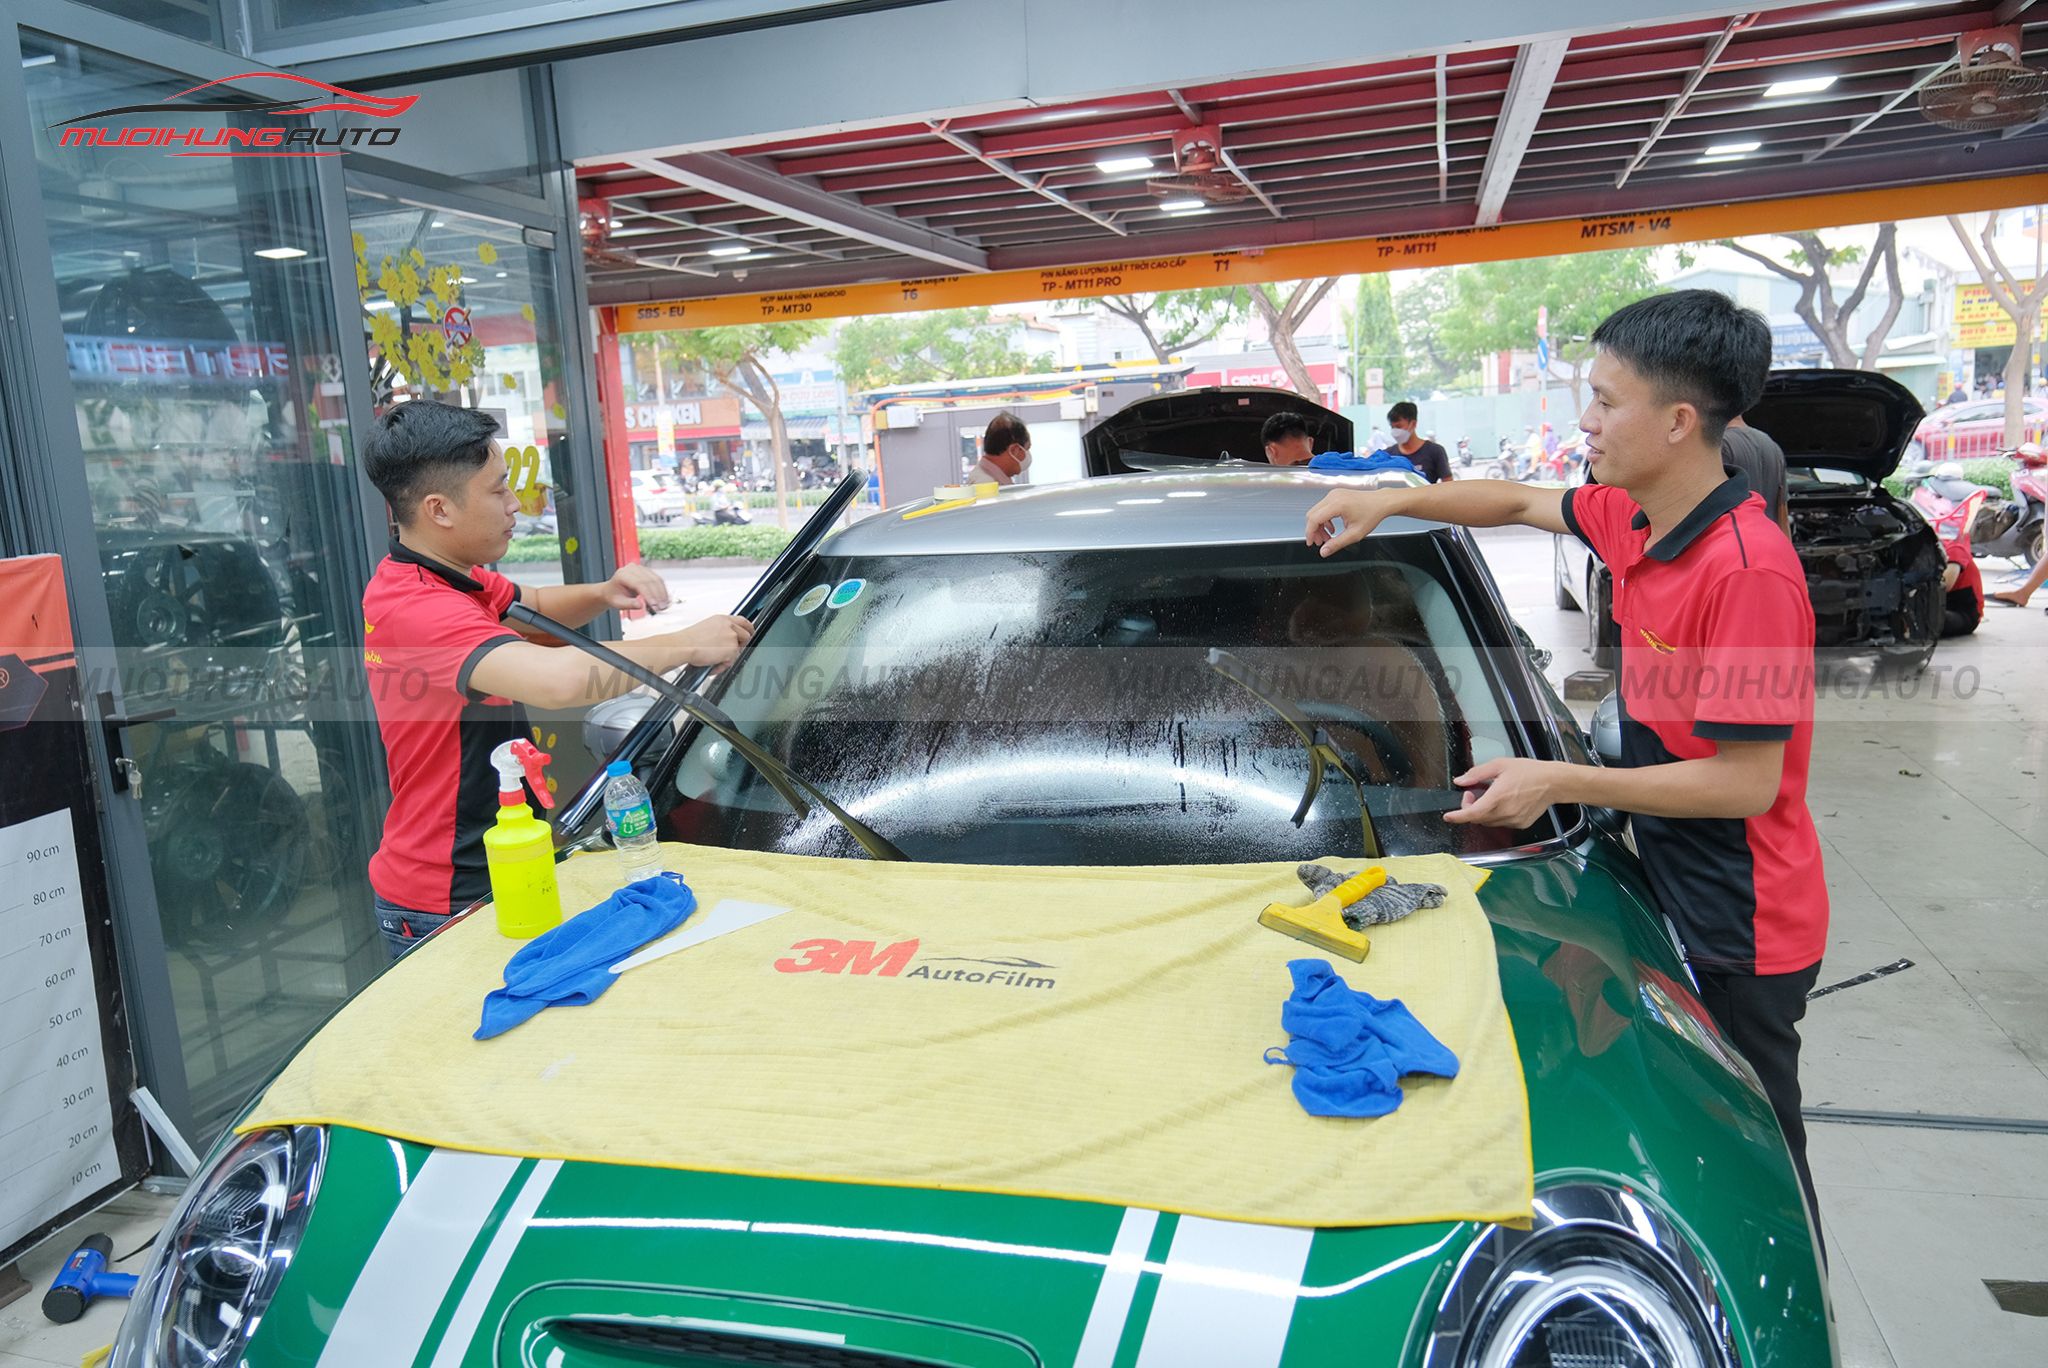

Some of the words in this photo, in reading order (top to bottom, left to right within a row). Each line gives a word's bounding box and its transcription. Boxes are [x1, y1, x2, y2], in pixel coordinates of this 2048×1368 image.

[1581, 220, 1635, 238] MTSM
[1649, 216, 1671, 231] V4
[1377, 246, 1393, 257] TP
[1403, 242, 1436, 255] MT11
[1150, 259, 1168, 269] CAO
[1214, 259, 1229, 272] T1
[813, 289, 847, 298] ANDROID
[1042, 282, 1056, 292] TP
[1065, 279, 1093, 290] MT11
[1096, 276, 1121, 288] PRO
[902, 288, 918, 301] T6
[637, 308, 659, 319] SBS
[669, 306, 685, 317] EU
[761, 305, 774, 315] TP
[782, 303, 812, 314] MT30
[26, 849, 41, 863] 90
[43, 845, 60, 858] cm
[33, 891, 47, 905] 80
[49, 885, 65, 899] cm
[38, 933, 53, 947] 70
[55, 927, 71, 940] cm
[774, 938, 920, 977] 3M
[906, 966, 1056, 989] AutoFilm
[45, 974, 58, 988] 60
[60, 967, 76, 981] cm
[49, 1014, 64, 1029] 50
[65, 1006, 82, 1021] cm
[56, 1054, 69, 1068] 40
[71, 1046, 89, 1061] cm
[62, 1094, 76, 1109] 30
[78, 1085, 94, 1101] cm
[68, 1133, 81, 1149] 20
[83, 1124, 99, 1139] cm
[72, 1171, 82, 1186] 10
[84, 1161, 102, 1177] cm
